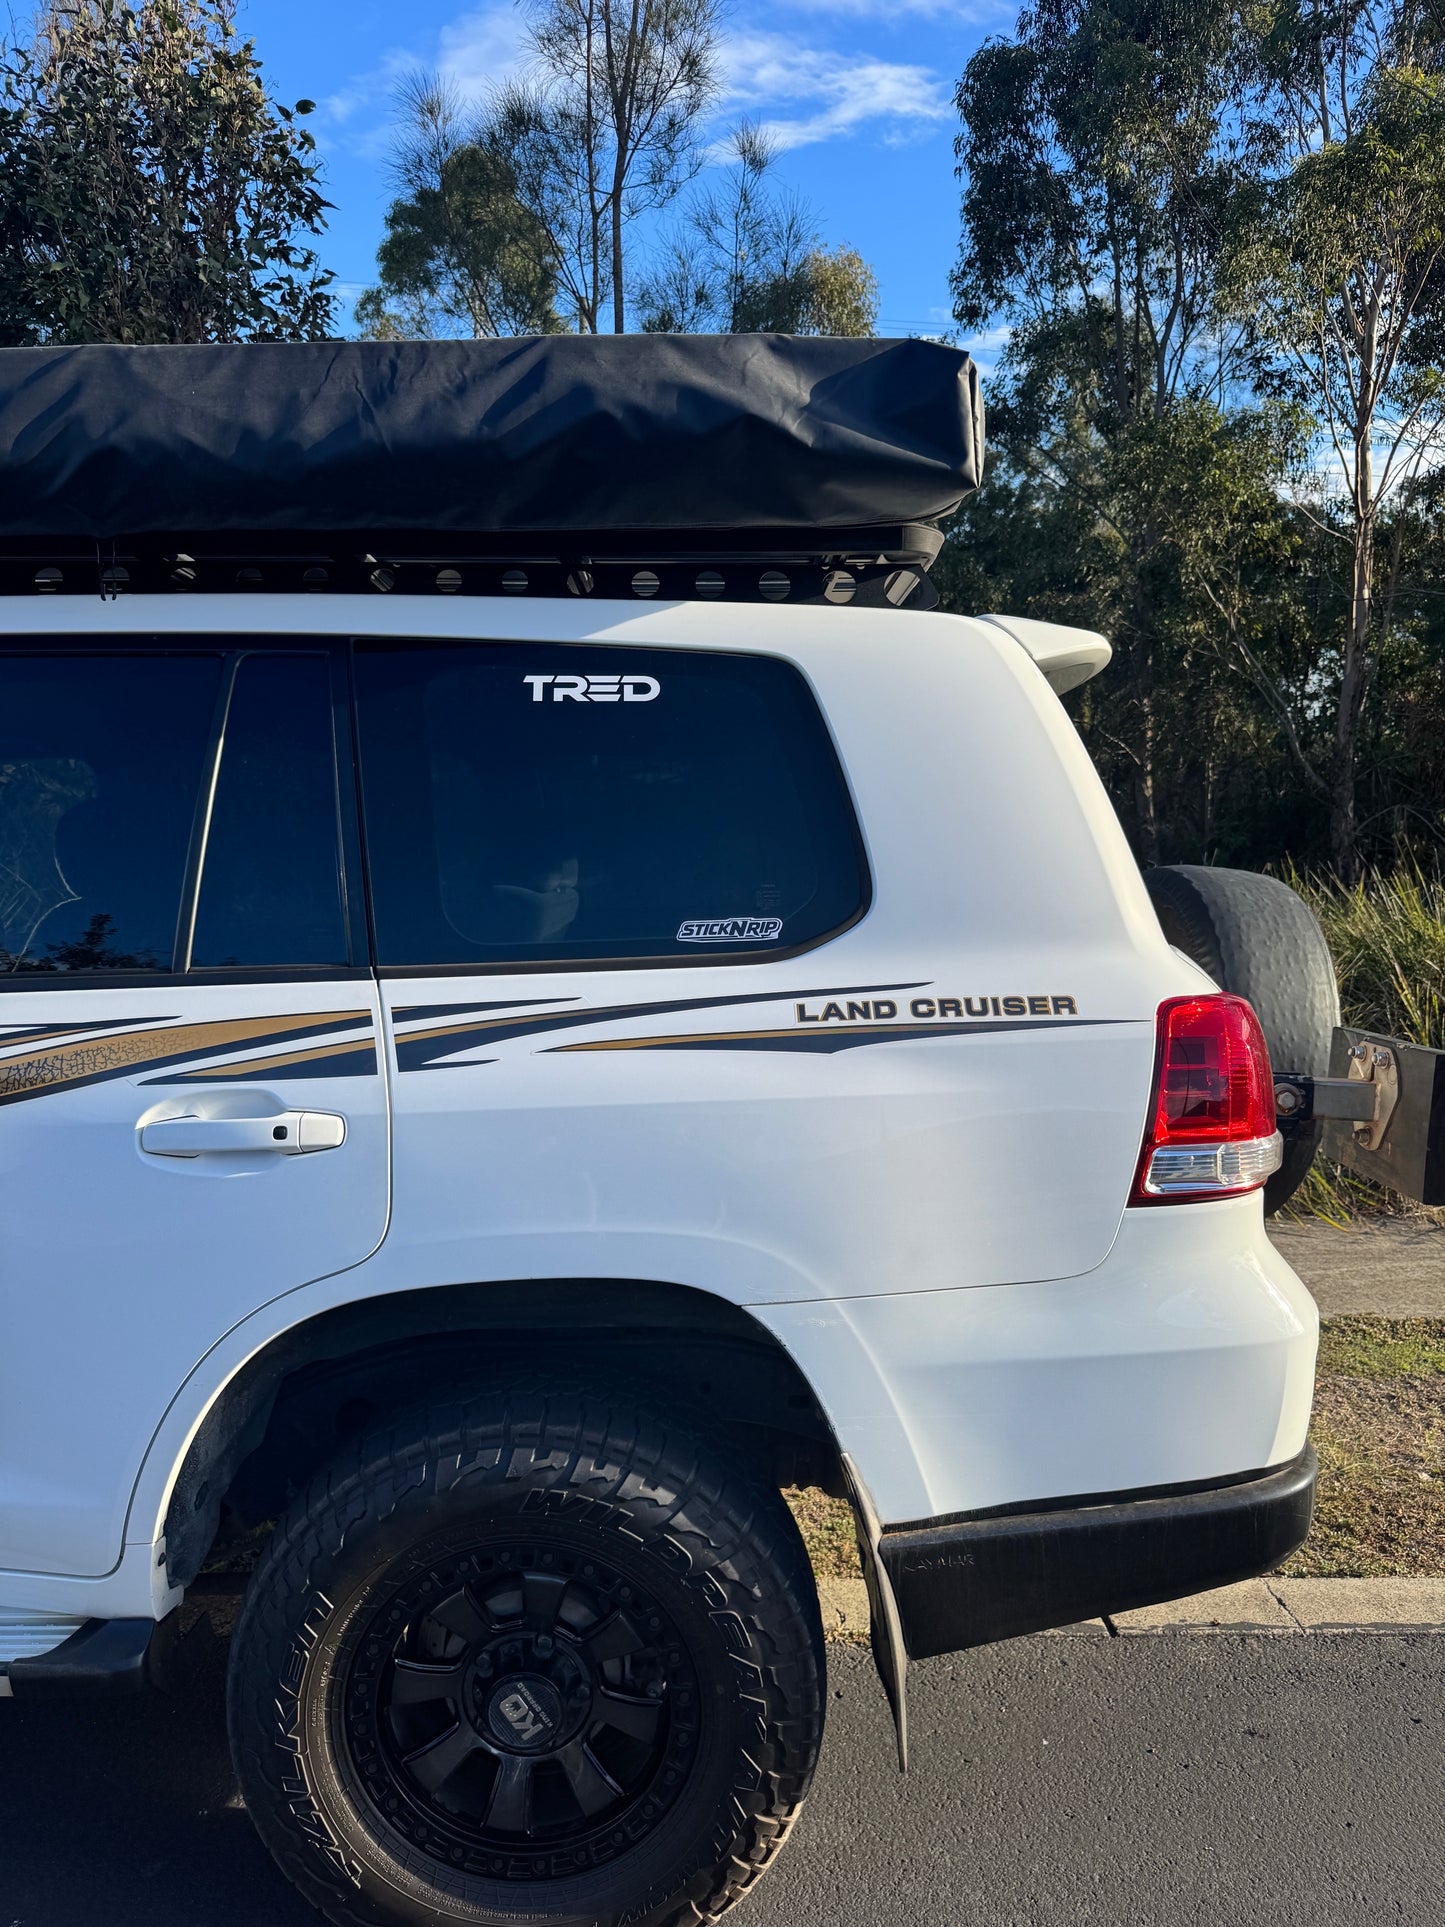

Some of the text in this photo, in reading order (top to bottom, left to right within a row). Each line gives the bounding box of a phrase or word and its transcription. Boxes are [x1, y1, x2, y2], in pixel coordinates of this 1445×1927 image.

[523, 675, 661, 702] TRED
[796, 995, 1078, 1022] LAND CRUISER
[274, 1590, 362, 1889] FALKEN
